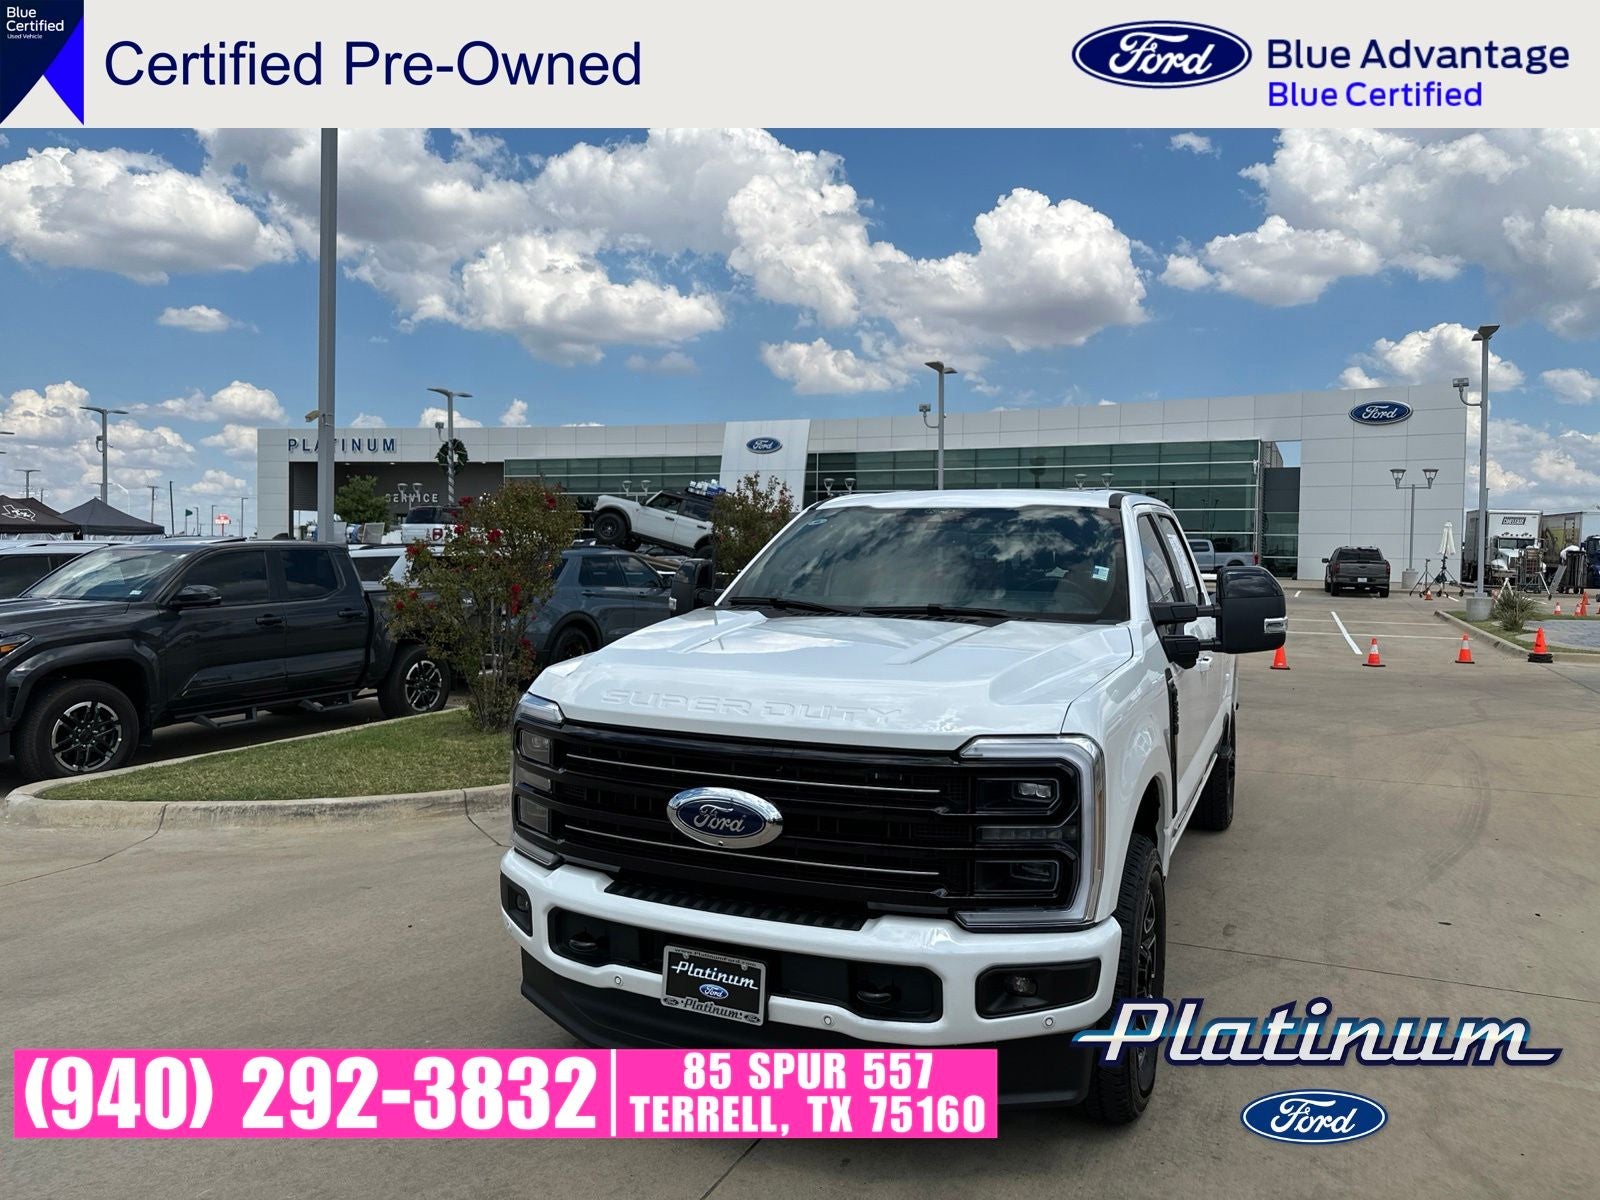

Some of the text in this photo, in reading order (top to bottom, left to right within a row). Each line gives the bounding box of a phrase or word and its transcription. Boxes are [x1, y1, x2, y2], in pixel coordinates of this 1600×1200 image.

[1361, 404, 1399, 420] Ford
[287, 437, 396, 451] PLINUM
[385, 492, 439, 503] SERVICE
[601, 689, 903, 724] SUPER DUTY
[692, 803, 747, 833] Ford
[671, 960, 759, 990] Platinum
